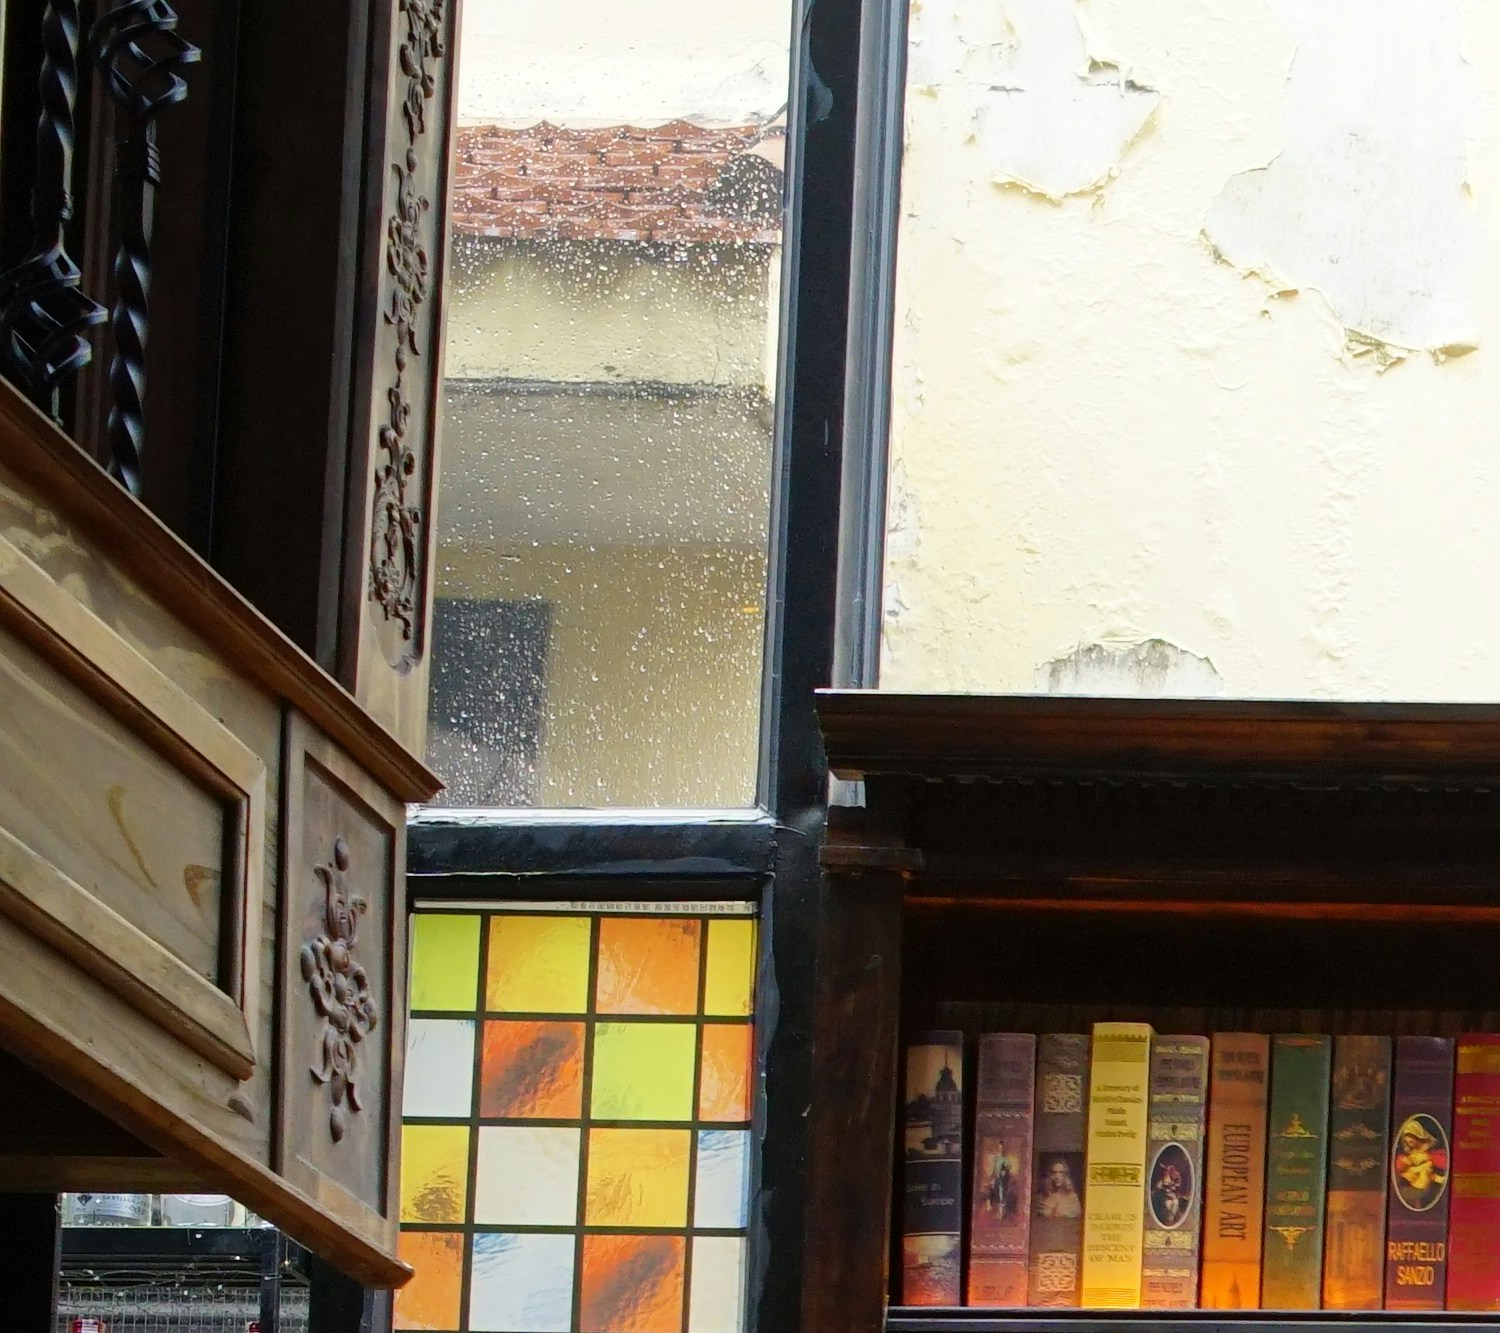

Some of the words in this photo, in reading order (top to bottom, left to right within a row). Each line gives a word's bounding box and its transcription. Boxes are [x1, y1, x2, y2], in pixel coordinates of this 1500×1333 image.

[1220, 1123, 1251, 1205] EUROPEAN
[1219, 1211, 1246, 1240] ART
[1388, 1241, 1445, 1262] RAFFAELLO
[1397, 1265, 1435, 1285] SANZIO
